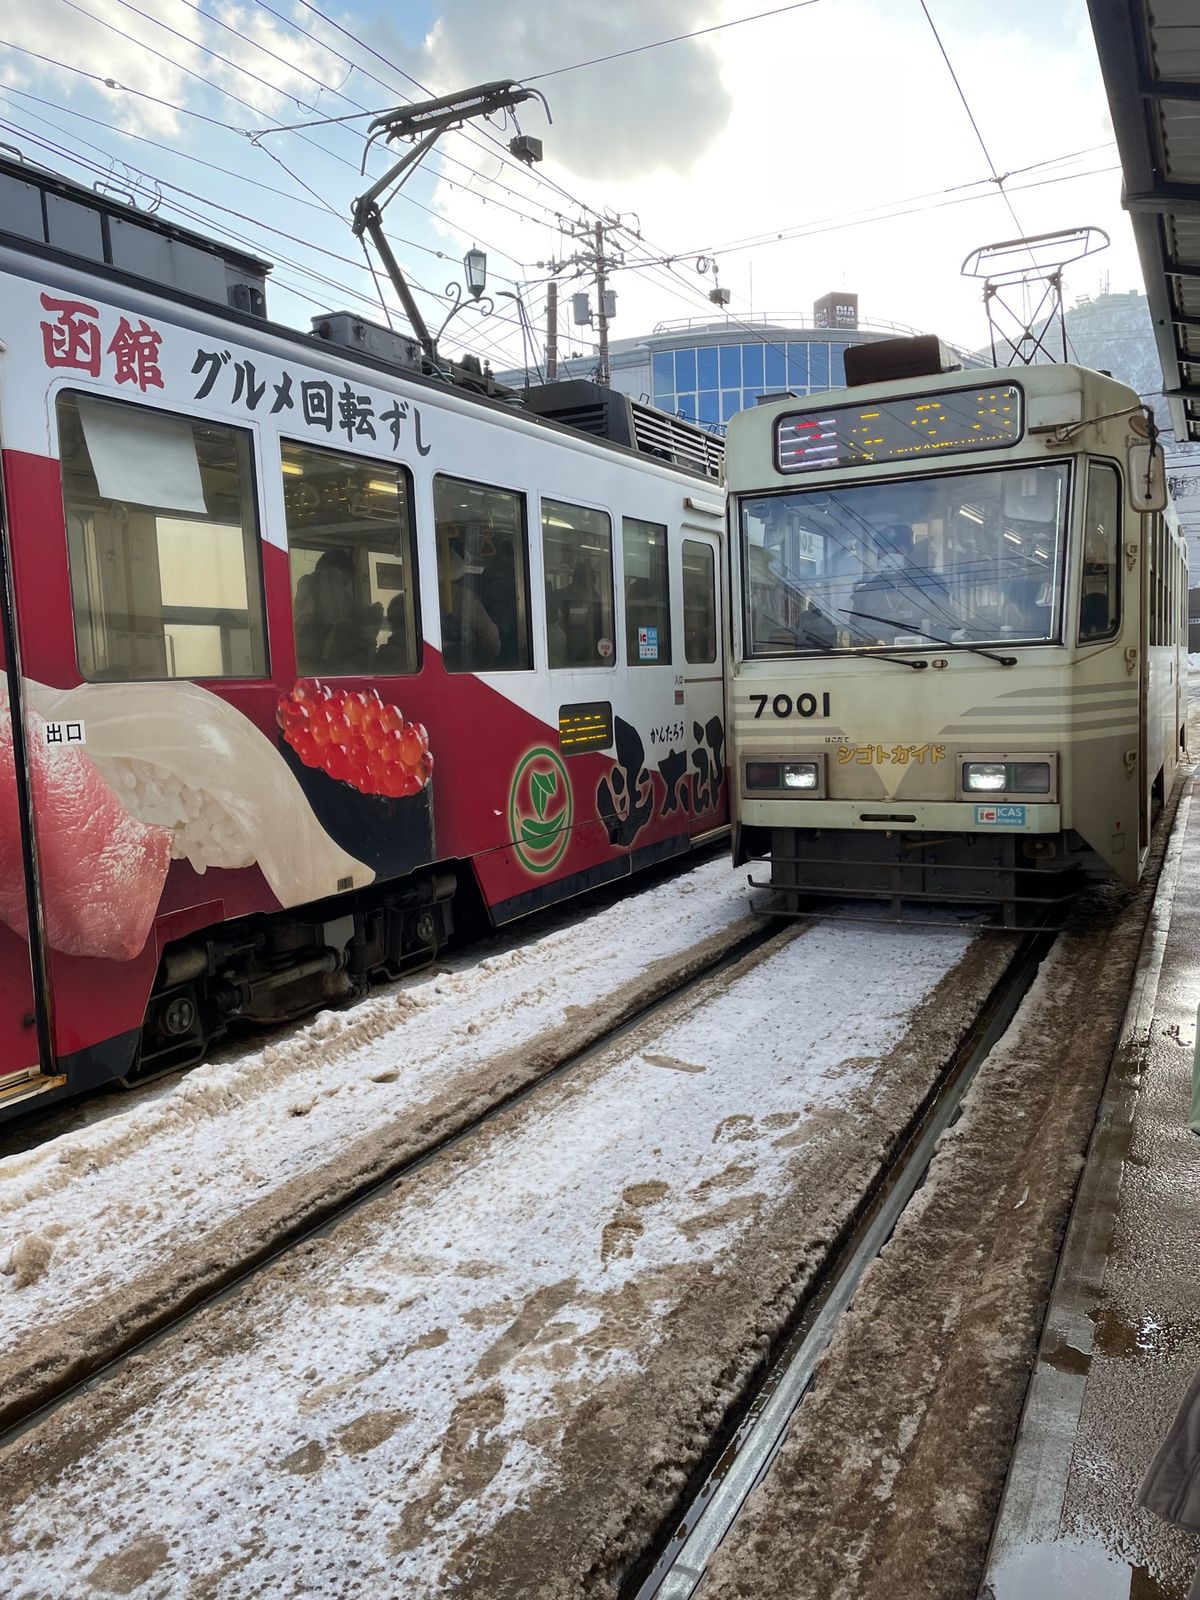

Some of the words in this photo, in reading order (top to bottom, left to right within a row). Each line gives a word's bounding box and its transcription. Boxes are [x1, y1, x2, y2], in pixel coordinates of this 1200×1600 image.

[40, 291, 165, 393] 函館
[190, 347, 432, 457] グルメ回転ずし
[674, 675, 684, 685] 入口
[750, 692, 830, 719] 7001
[46, 723, 82, 744] 出口
[650, 721, 684, 744] かんたろう
[825, 736, 850, 744] はこだて
[838, 744, 946, 765] シゴトガイド
[997, 807, 1022, 817] ICAS
